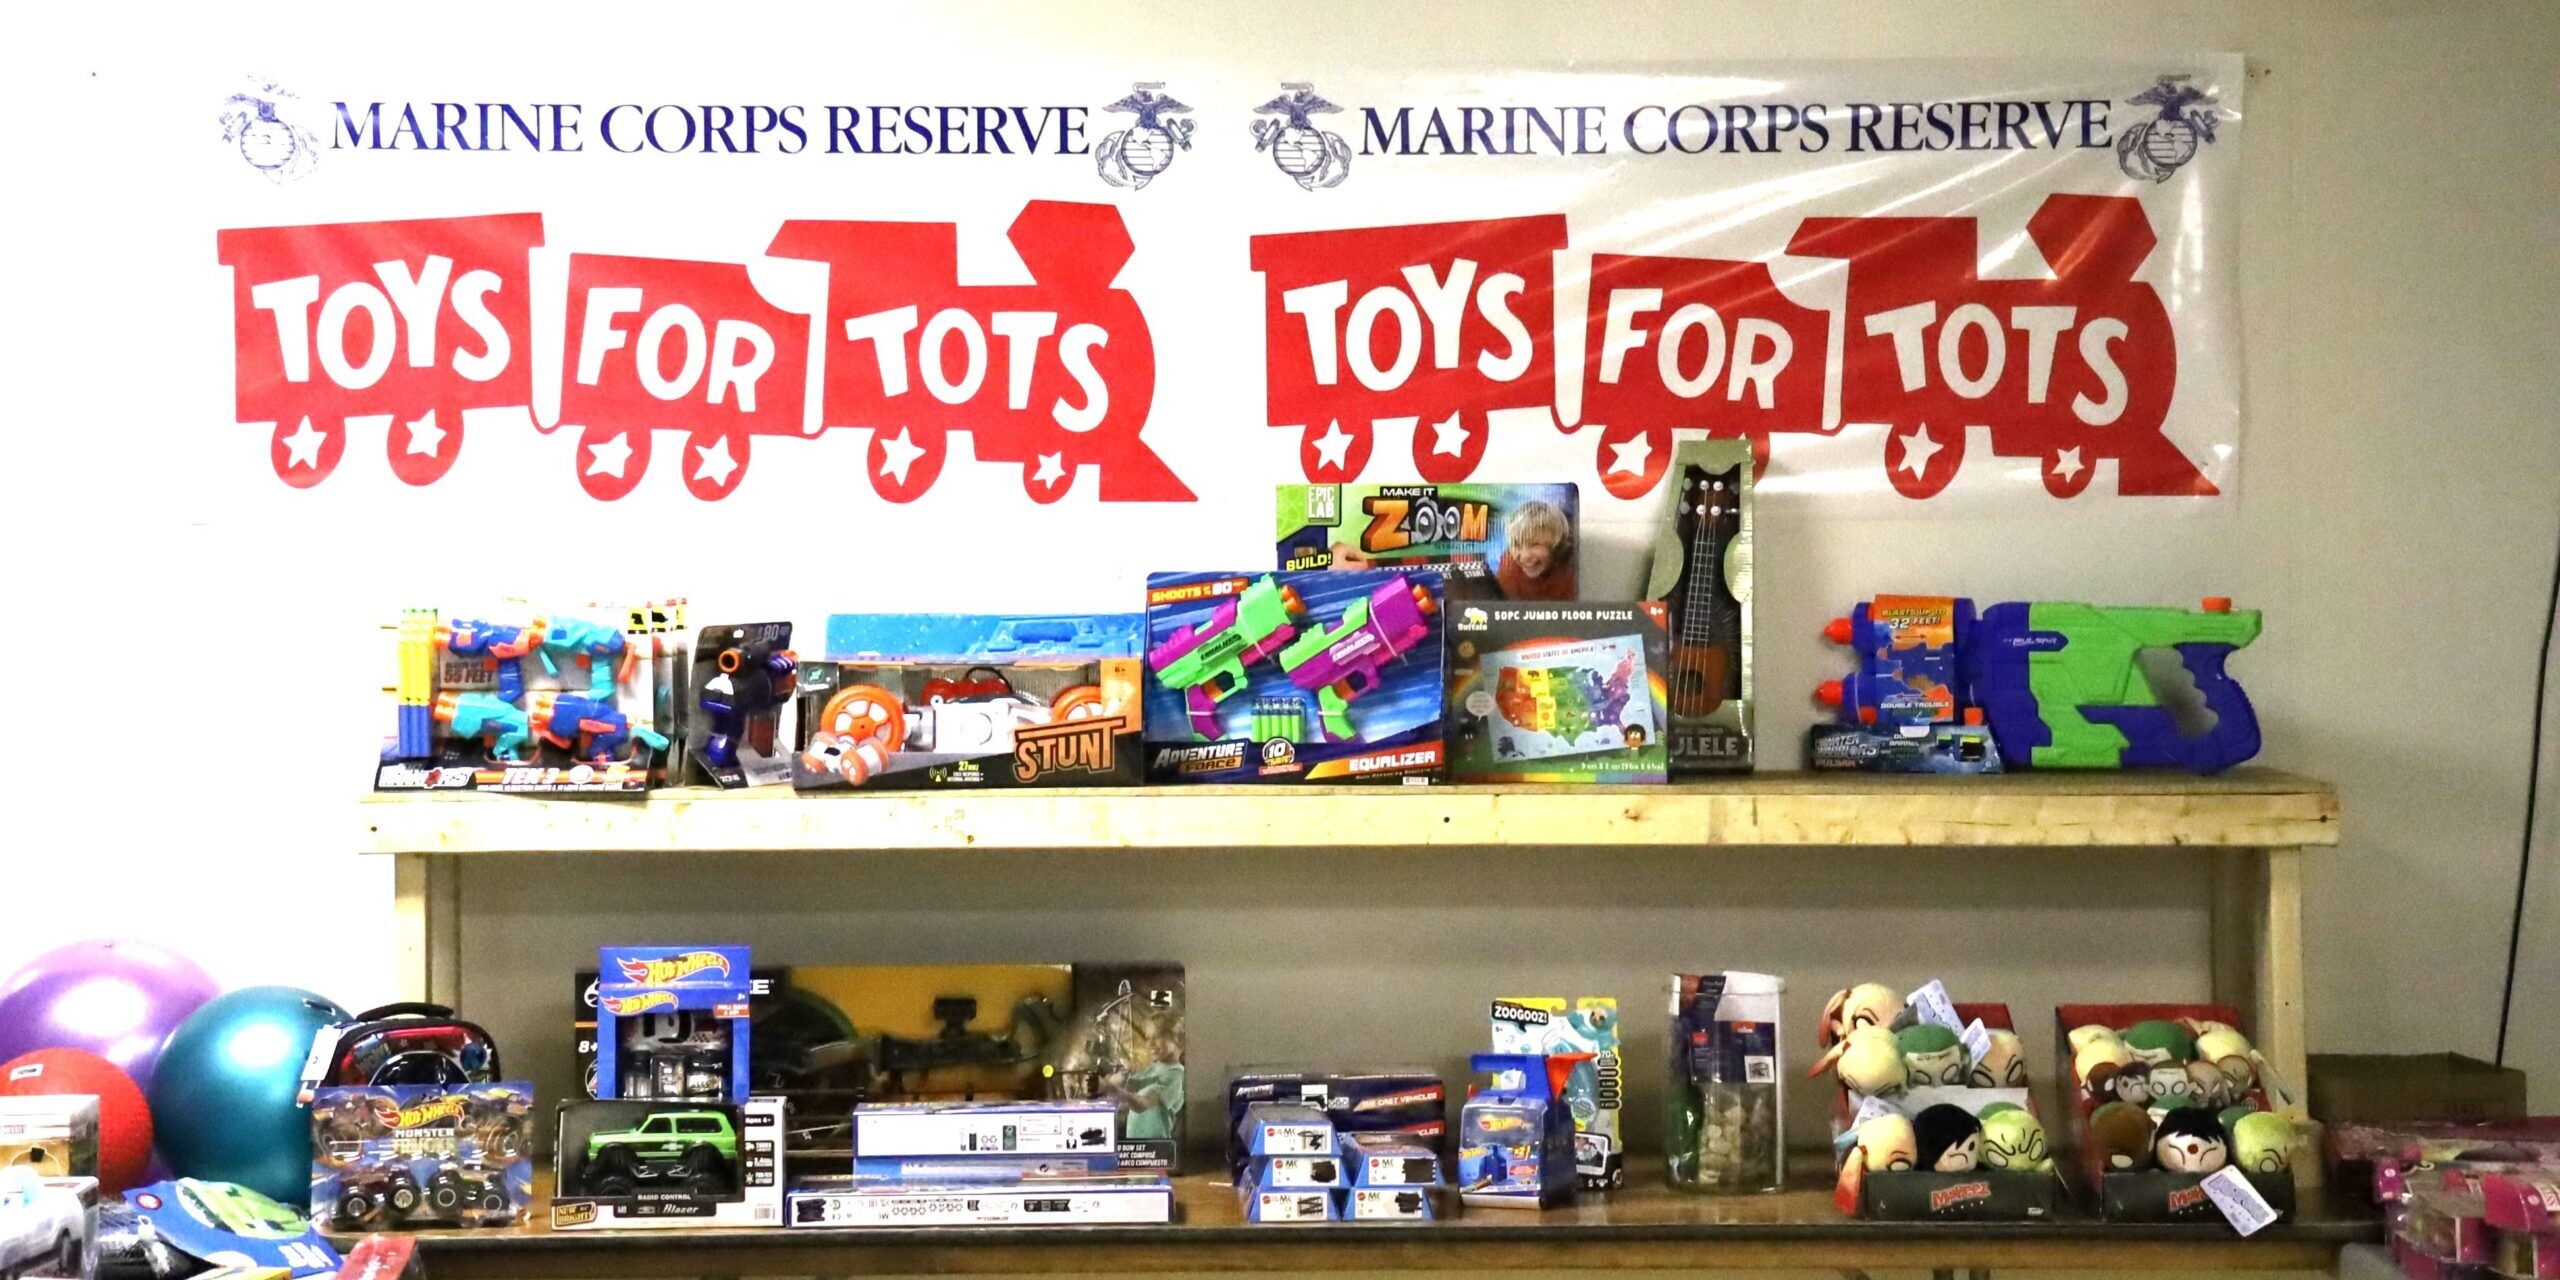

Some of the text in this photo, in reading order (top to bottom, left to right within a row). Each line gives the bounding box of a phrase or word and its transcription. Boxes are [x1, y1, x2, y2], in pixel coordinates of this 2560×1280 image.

[330, 103, 1090, 157] MARINE CORPS RESERVE
[1360, 99, 2113, 156] MARINE CORPS RESERVE
[251, 253, 1109, 433] TOYS FOR TOTS
[1282, 257, 2129, 426] TOYS FOR TOTS
[1308, 486, 1335, 500] EPIC
[1382, 487, 1435, 497] MAKE IT
[1309, 500, 1334, 519] LAB
[1285, 552, 1333, 571] BUILD!
[1151, 587, 1201, 602] SHOOTS
[1494, 610, 1633, 621] 50PC JUMBO FLOOR PUZZLE
[1889, 617, 1942, 629] 32 FEET!
[1014, 717, 1126, 782] STUNT
[1154, 742, 1245, 769] ADVENTURE
[1349, 751, 1436, 772] EQUALIZER
[1494, 1006, 1547, 1023] ZOOGOOZ!
[579, 1041, 598, 1053] 8+
[1401, 1093, 1437, 1102] VEHICLES
[396, 1127, 454, 1138] MONSTER
[559, 1207, 576, 1215] NEW
[663, 1203, 699, 1214] Blazer
[560, 1213, 590, 1222] BRIGHT
